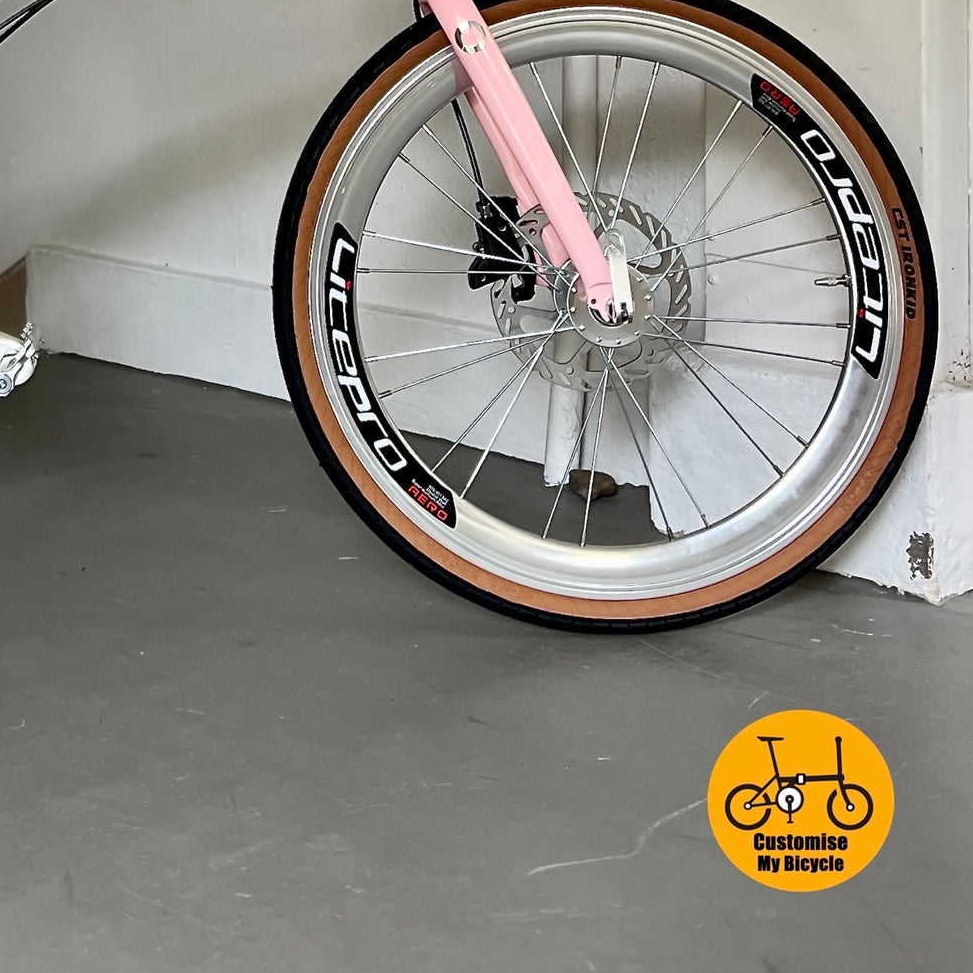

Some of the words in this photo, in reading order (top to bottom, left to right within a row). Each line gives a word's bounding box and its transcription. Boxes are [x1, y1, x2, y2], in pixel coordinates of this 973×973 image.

[759, 80, 801, 115] AERO
[892, 207, 912, 242] CST
[898, 243, 918, 320] IRONKID
[408, 484, 449, 522] AERO
